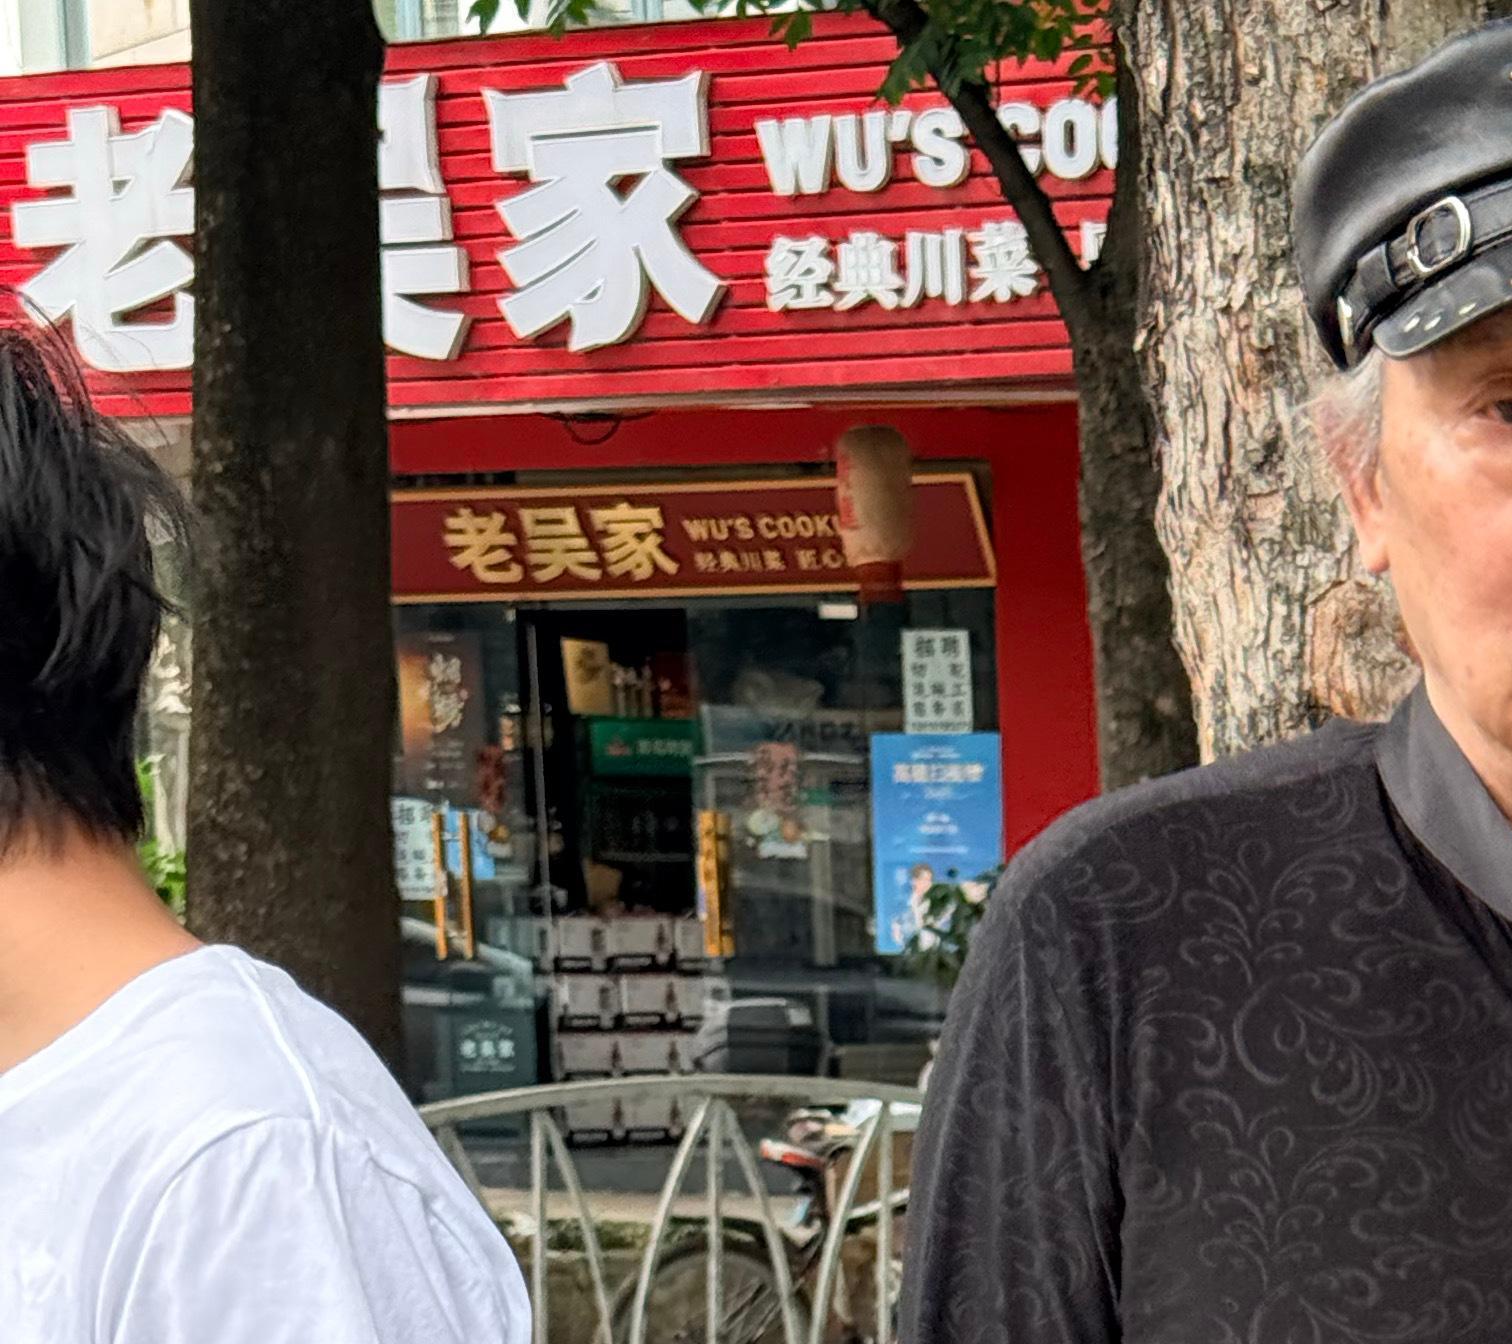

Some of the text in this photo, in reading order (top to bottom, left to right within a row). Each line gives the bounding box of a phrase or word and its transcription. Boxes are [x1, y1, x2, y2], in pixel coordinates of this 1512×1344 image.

[755, 106, 972, 196] WU'S
[764, 220, 1042, 312] 经典川菜
[443, 503, 680, 584] 老吴家
[682, 515, 755, 542] WU'S
